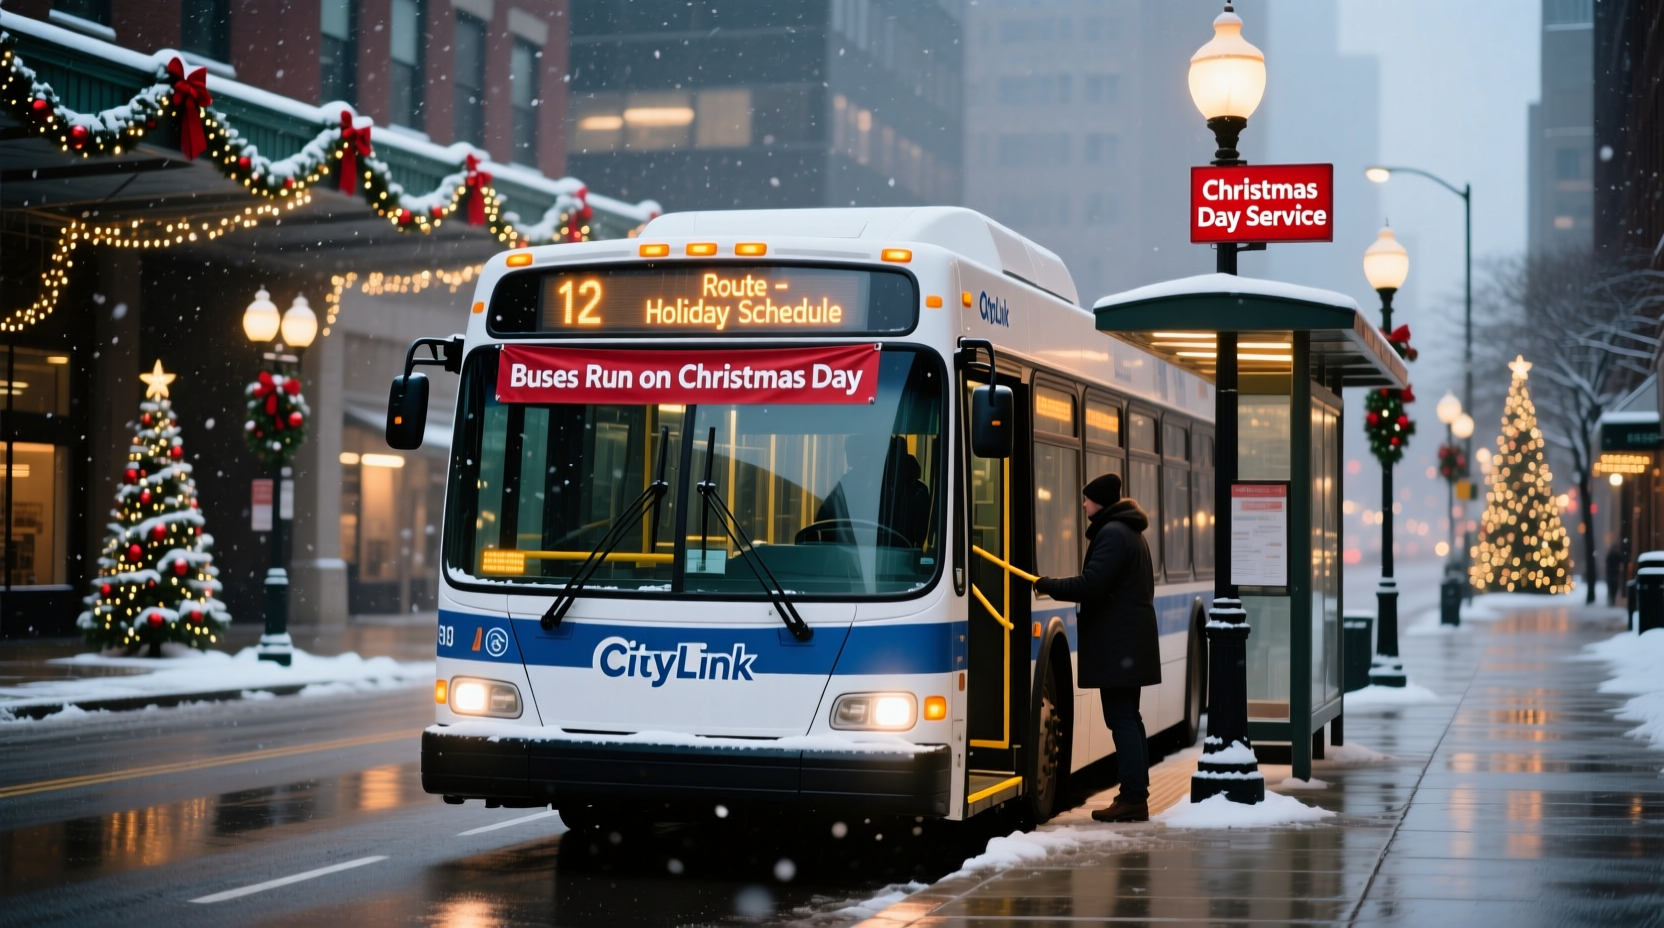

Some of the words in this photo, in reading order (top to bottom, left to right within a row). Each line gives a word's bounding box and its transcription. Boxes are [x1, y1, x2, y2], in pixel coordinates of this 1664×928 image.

[1202, 177, 1318, 201] Christmas
[1197, 206, 1242, 233] Day
[1246, 203, 1327, 227] Service
[703, 273, 767, 297] Route
[558, 280, 602, 324] 12
[646, 298, 730, 330] Holiday
[738, 298, 842, 323] Schedule
[510, 363, 579, 388] Buses
[585, 364, 633, 389] Run
[639, 369, 672, 389] on
[678, 363, 806, 390] Christmas
[812, 363, 863, 396] Day
[597, 638, 756, 688] CityLink
